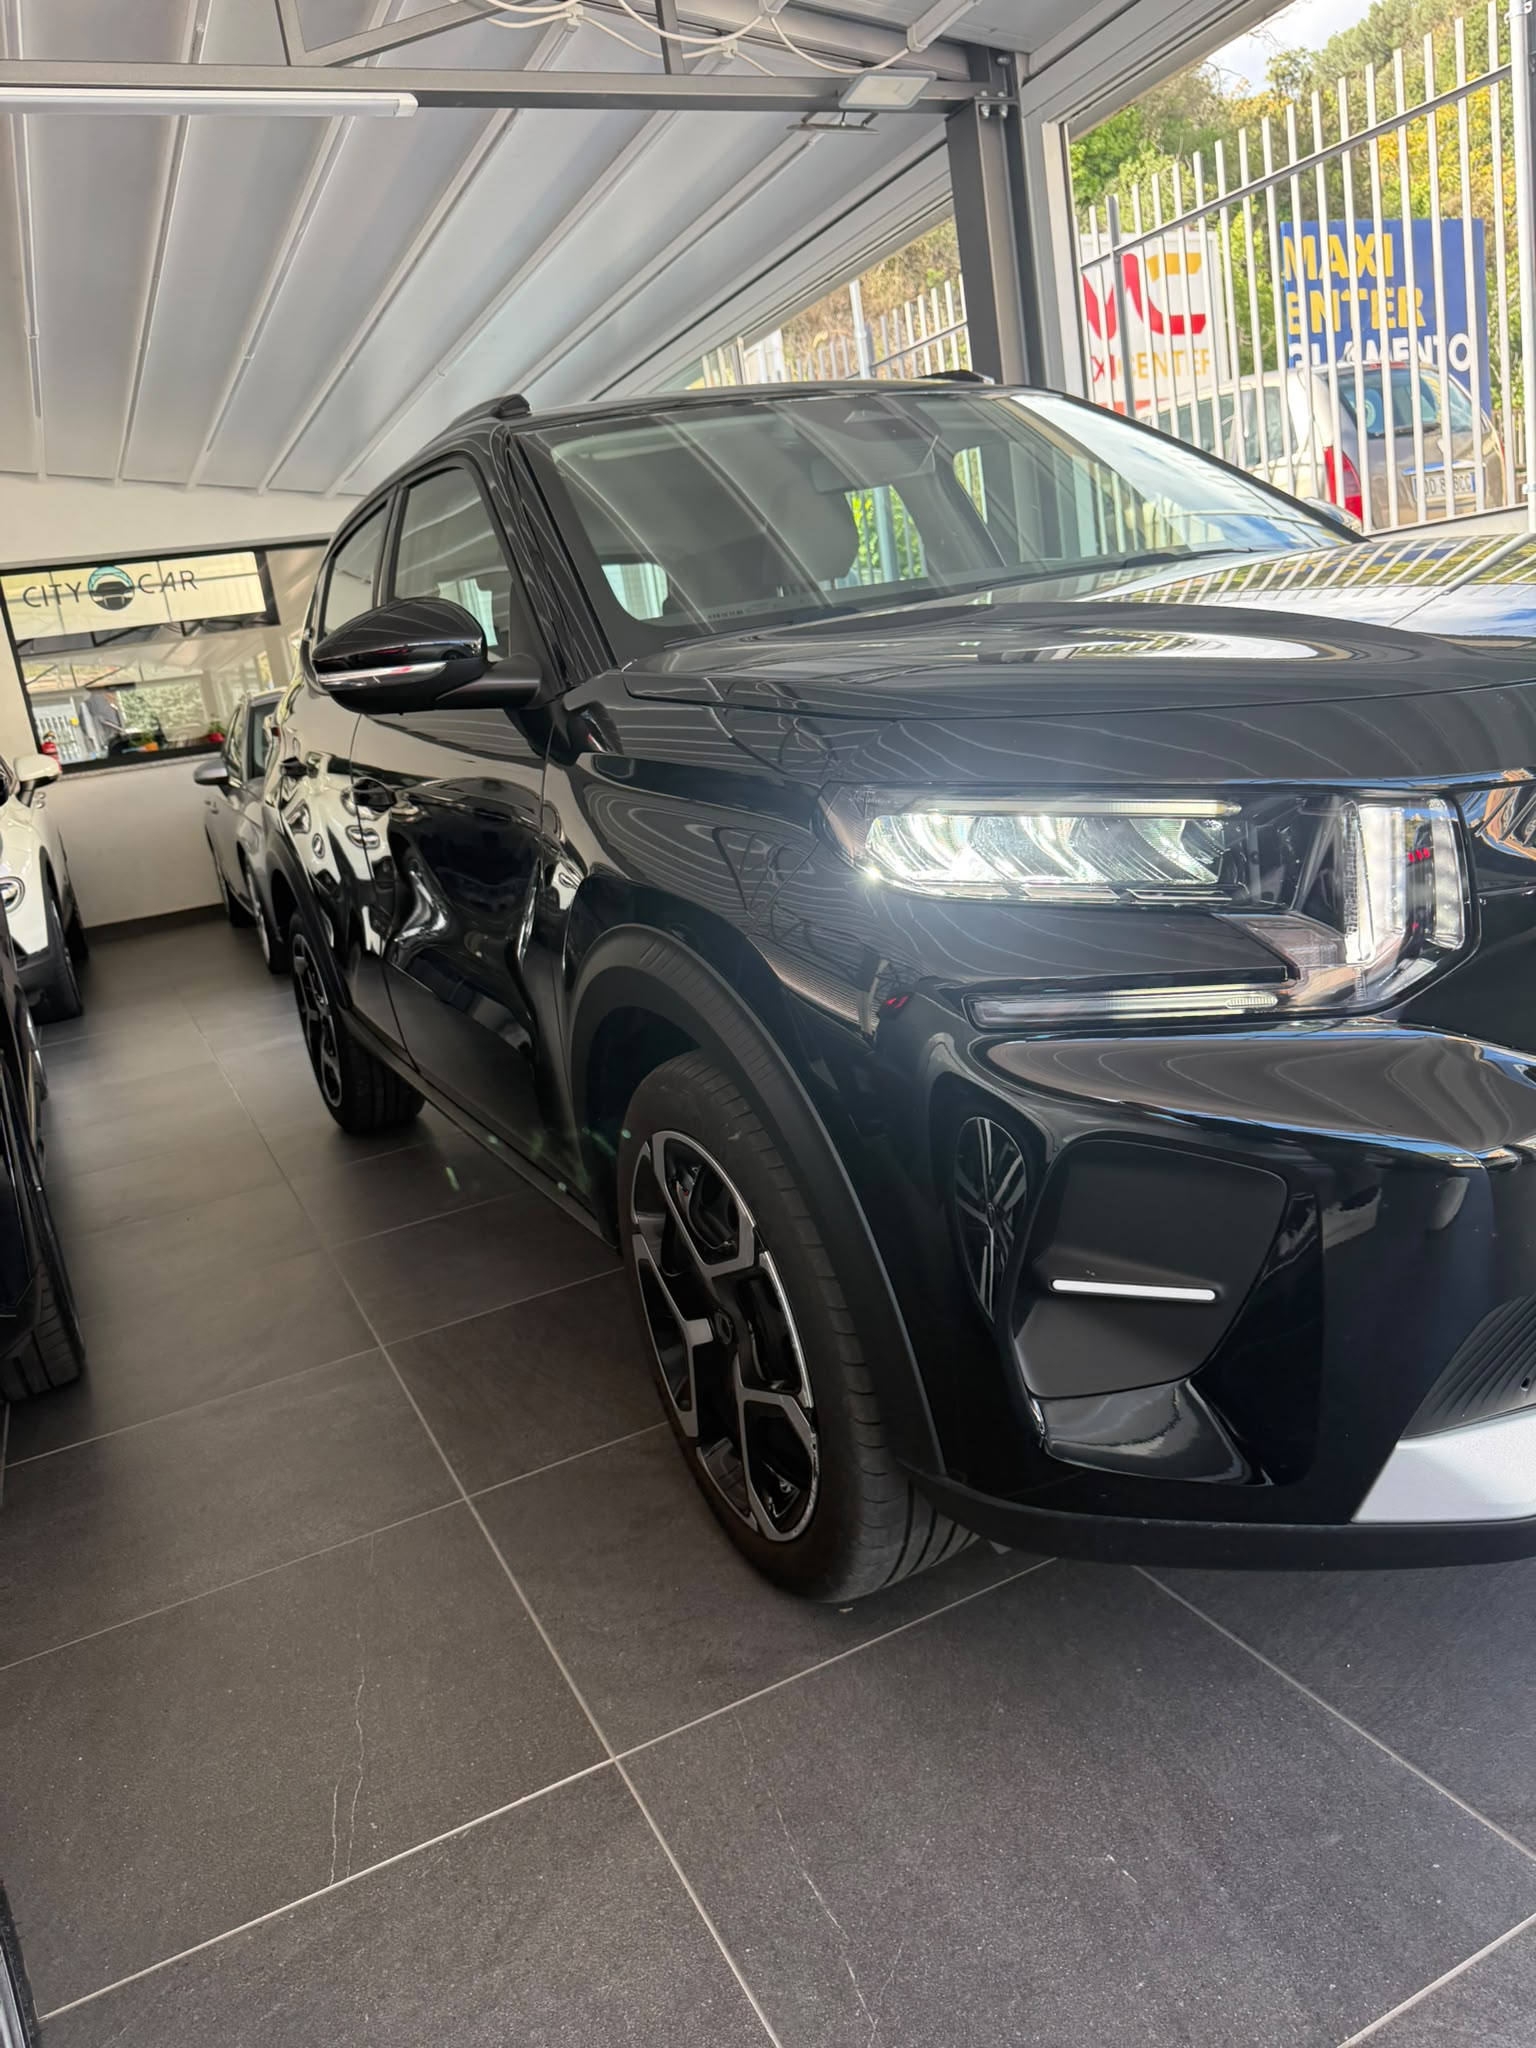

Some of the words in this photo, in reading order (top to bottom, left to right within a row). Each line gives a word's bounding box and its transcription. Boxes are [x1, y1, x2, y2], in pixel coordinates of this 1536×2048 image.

[1283, 232, 1395, 282] MAXI
[22, 581, 82, 608] CITY
[138, 569, 197, 594] CAR
